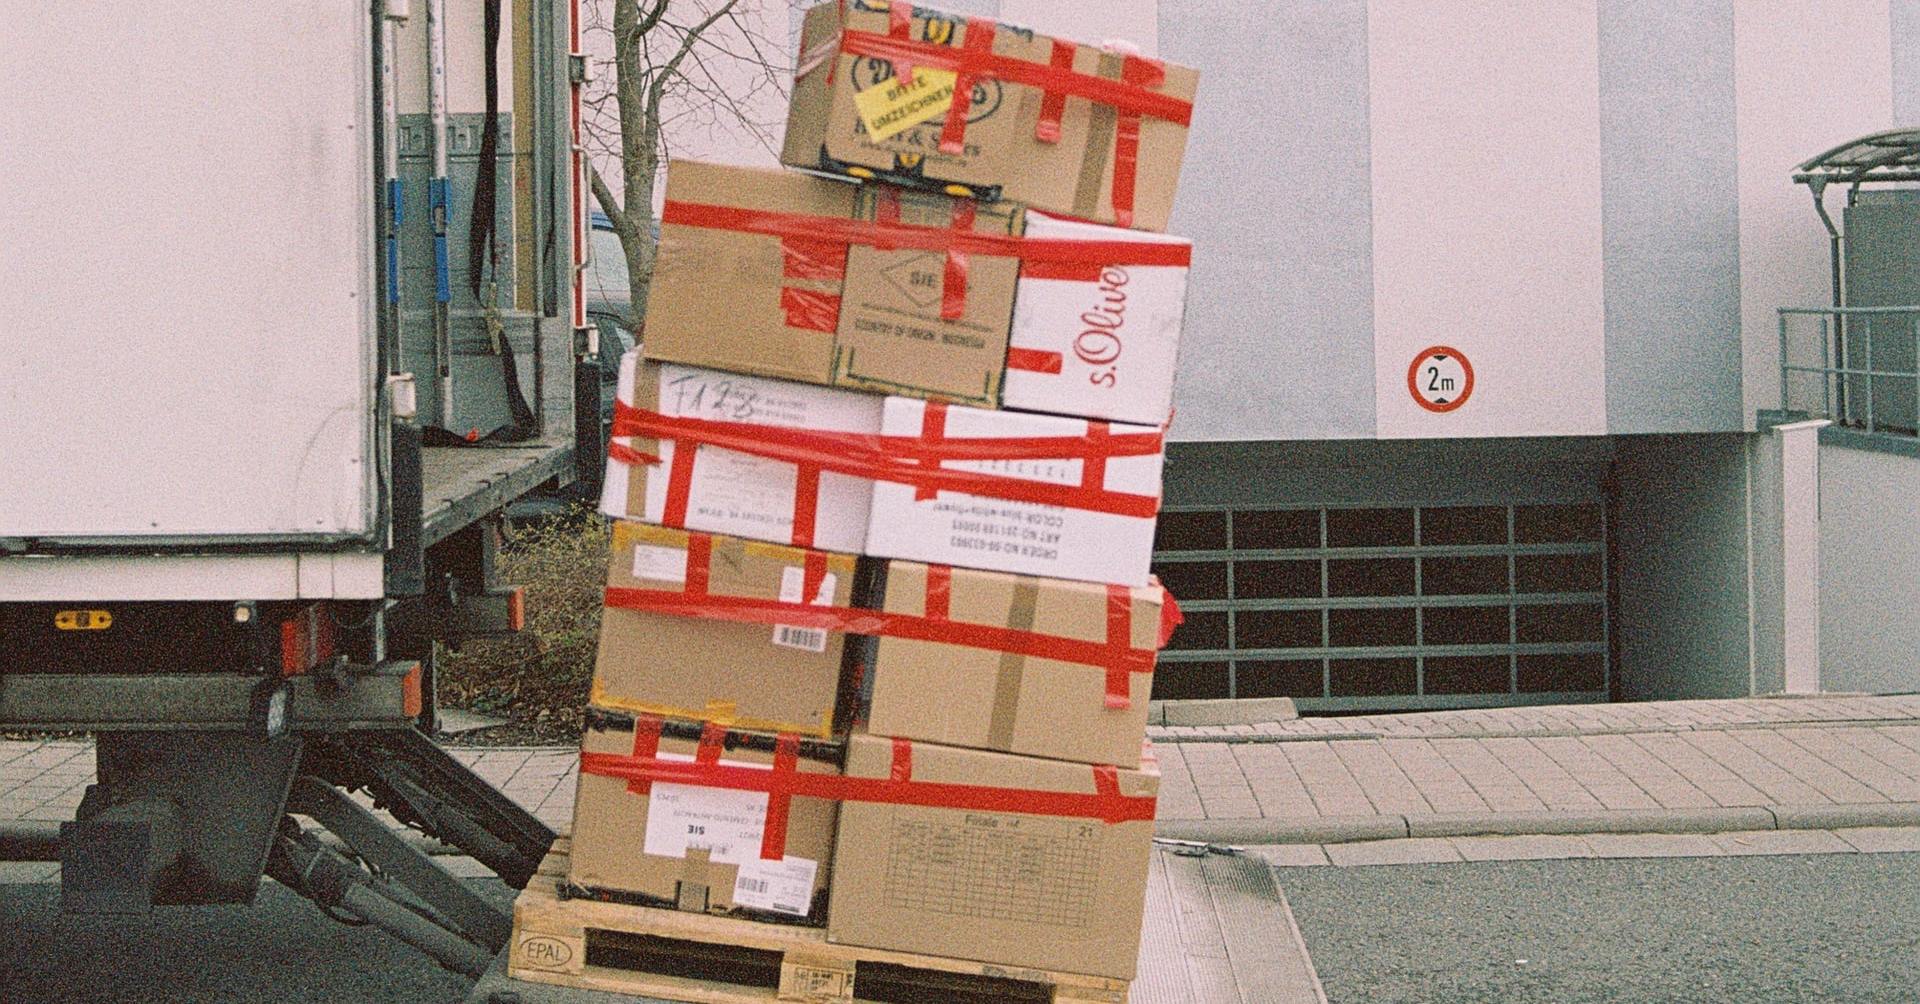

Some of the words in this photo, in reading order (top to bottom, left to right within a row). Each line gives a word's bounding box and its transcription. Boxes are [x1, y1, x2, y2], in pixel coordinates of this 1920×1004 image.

[886, 75, 927, 102] BITTE
[910, 271, 938, 288] SIE
[1074, 265, 1129, 388] s.Olive
[688, 824, 705, 835] SIE
[526, 941, 563, 961] EPAL
